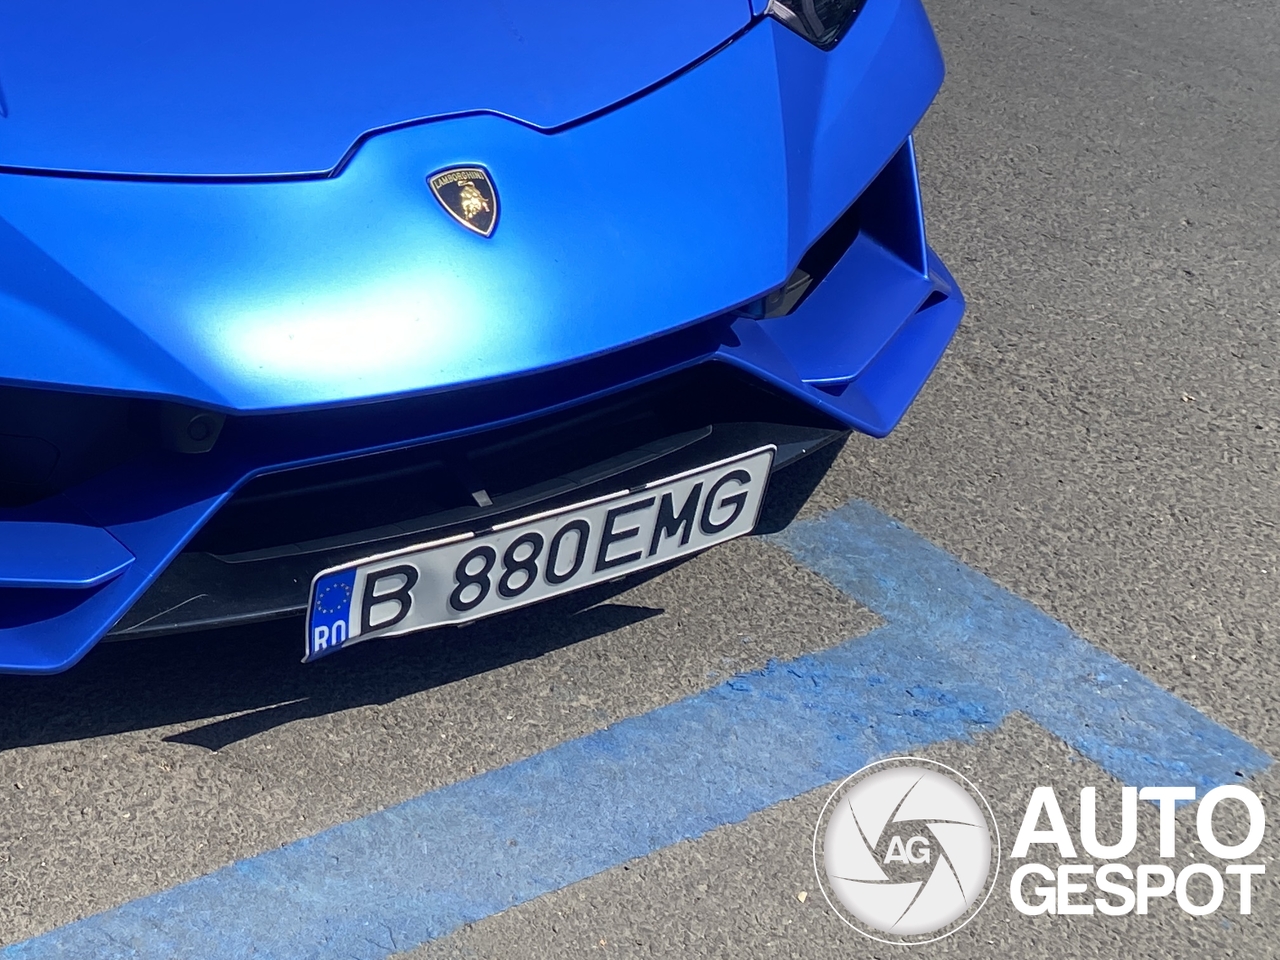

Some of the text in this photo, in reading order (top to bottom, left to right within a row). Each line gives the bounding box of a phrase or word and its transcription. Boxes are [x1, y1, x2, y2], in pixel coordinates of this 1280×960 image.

[433, 170, 485, 189] LAMBORGHINI
[360, 468, 751, 636] B 880EMG
[314, 619, 347, 652] RO
